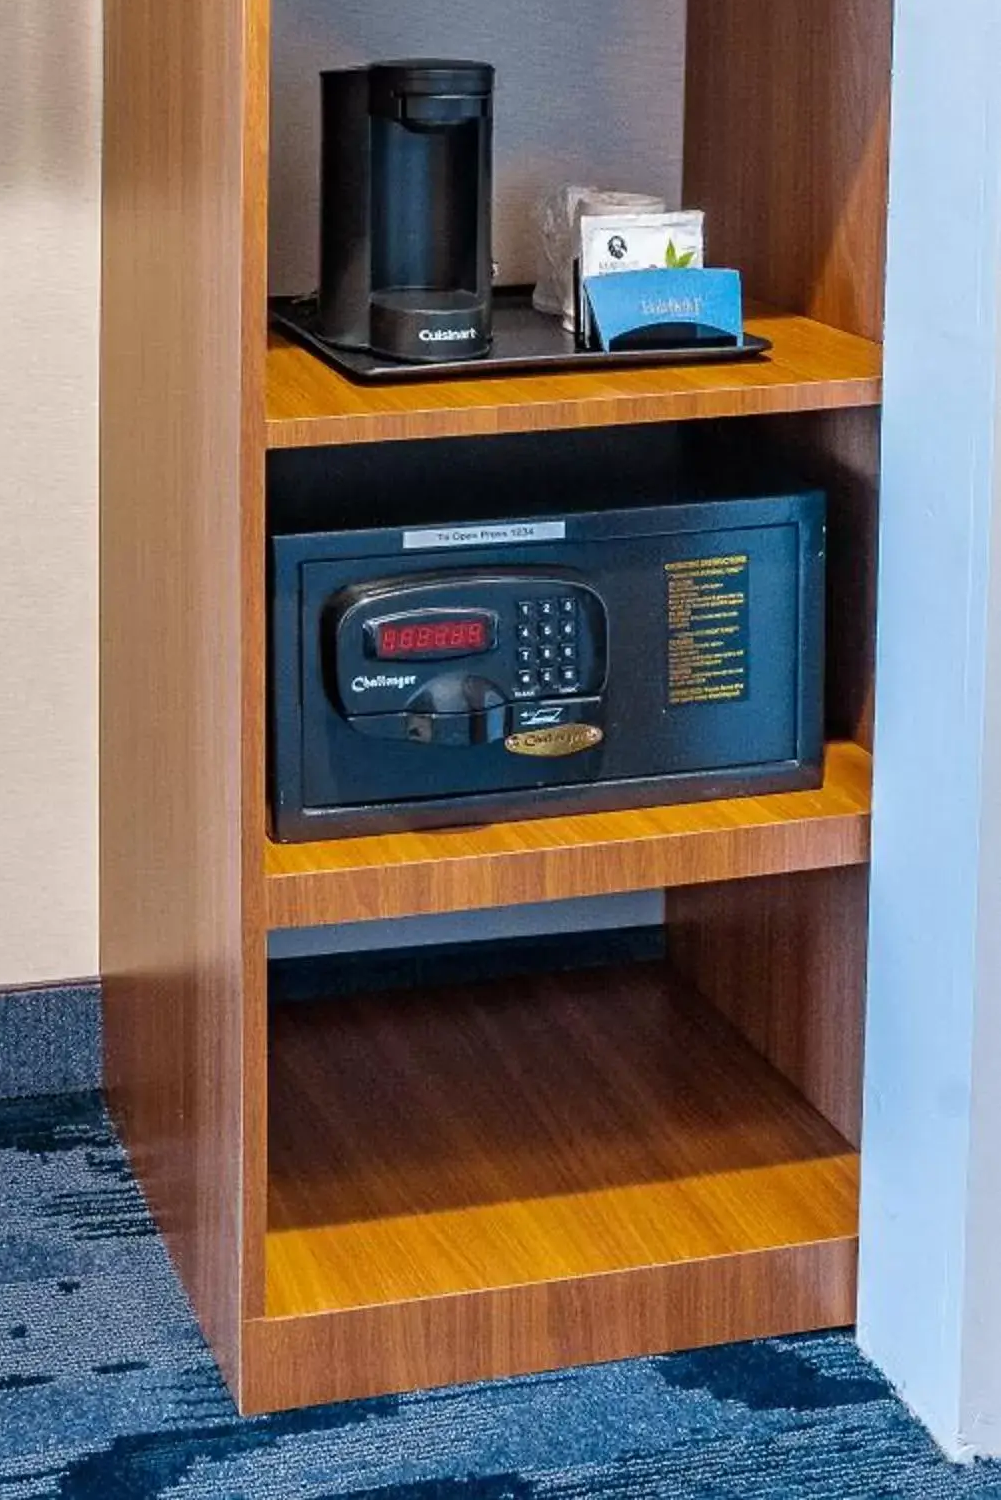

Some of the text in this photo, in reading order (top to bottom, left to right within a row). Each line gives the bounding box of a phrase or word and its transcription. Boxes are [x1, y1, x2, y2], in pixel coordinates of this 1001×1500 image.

[418, 327, 477, 342] Cuisinart
[452, 532, 478, 541] Open
[510, 528, 534, 536] 1234
[351, 675, 417, 692] Challenger
